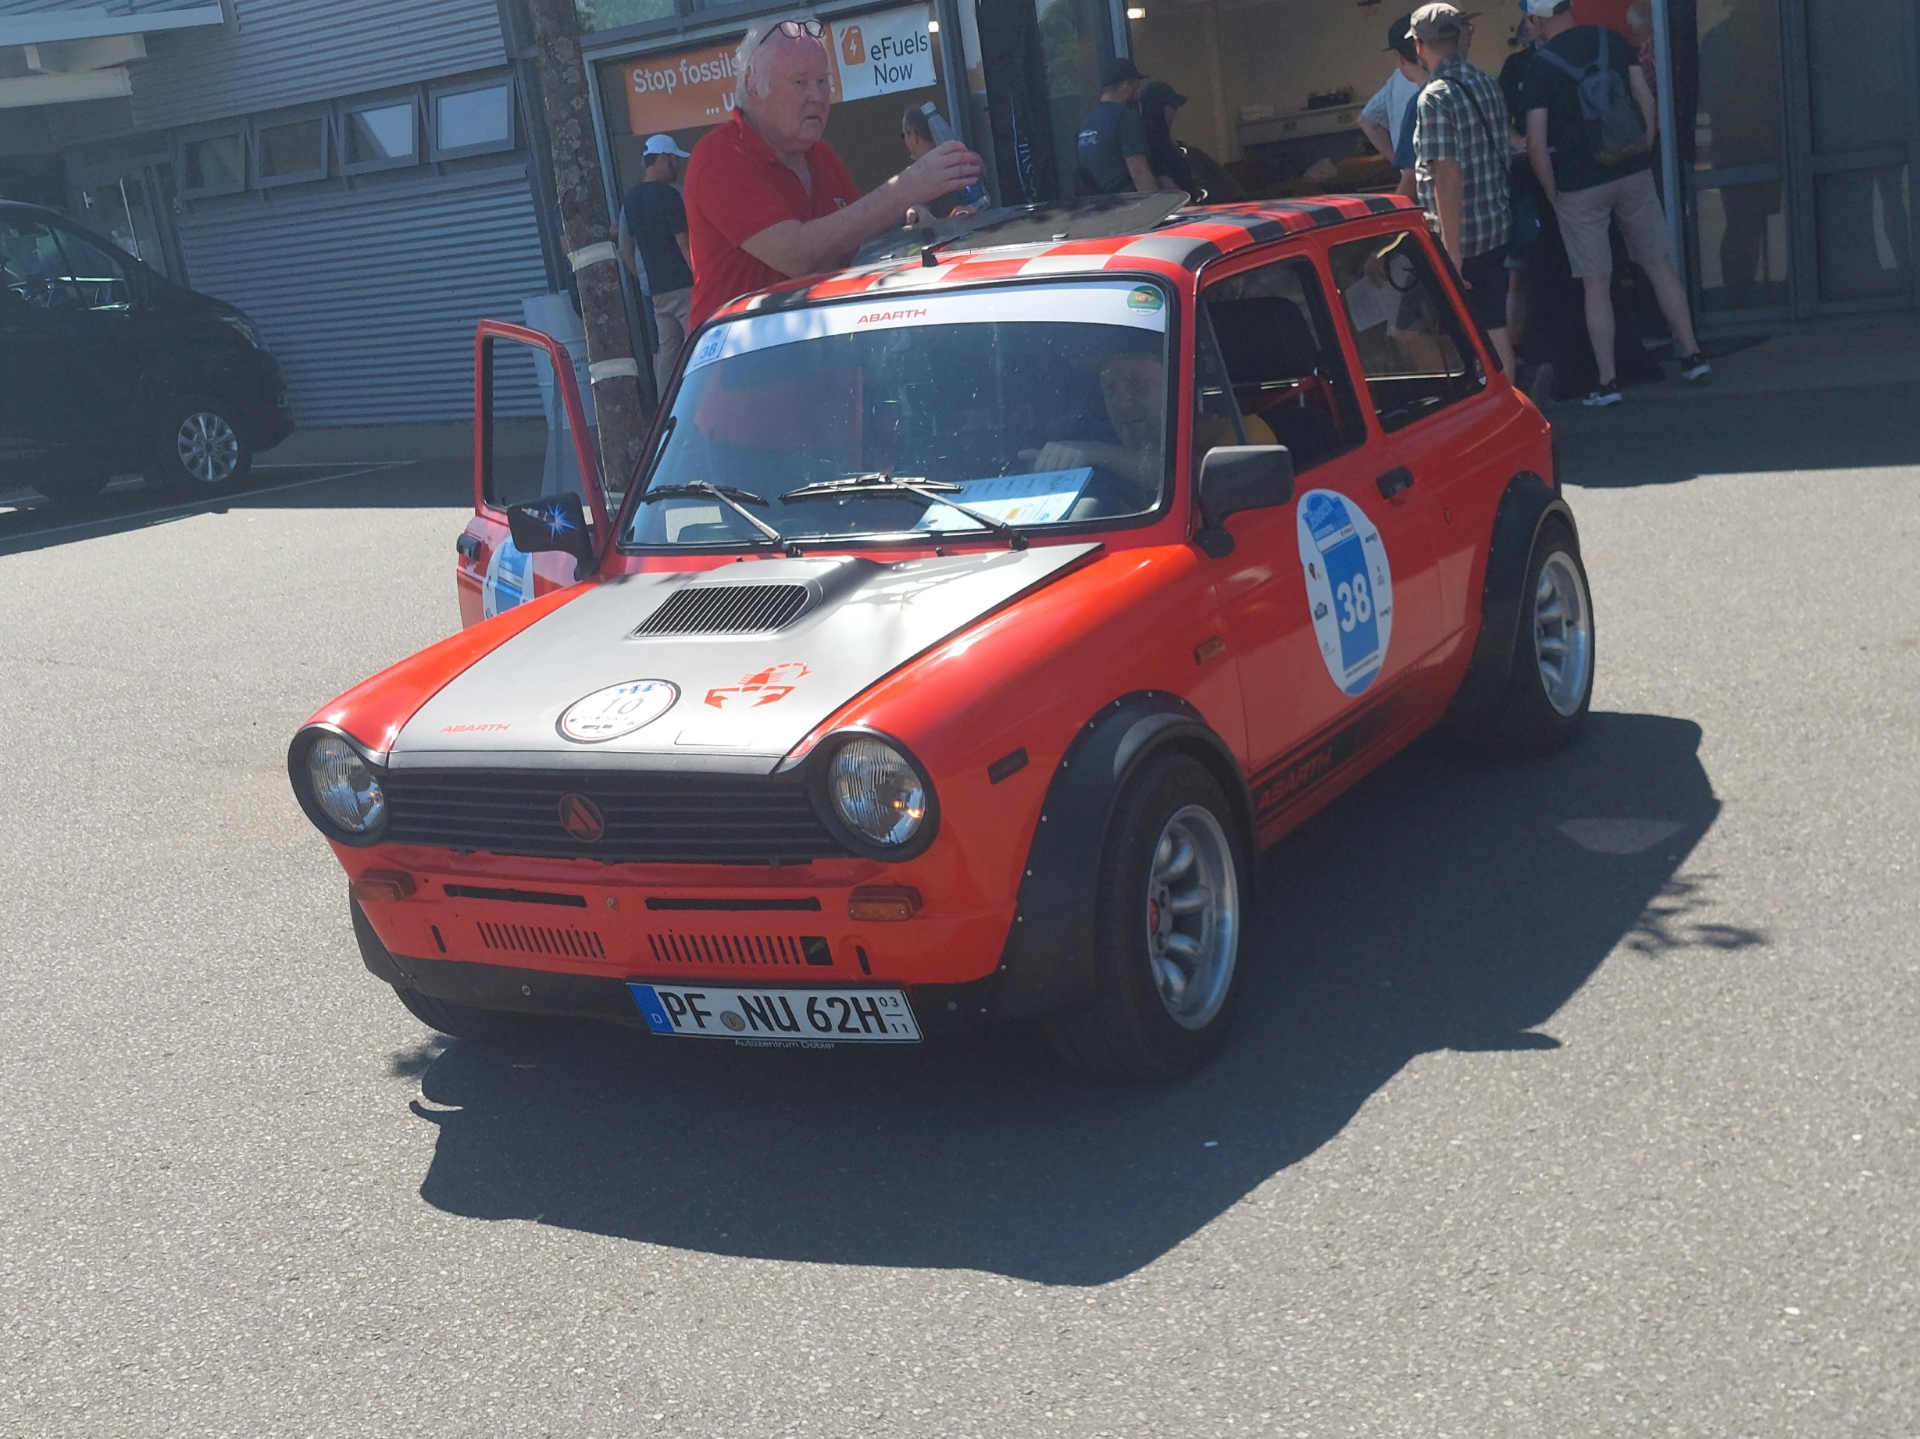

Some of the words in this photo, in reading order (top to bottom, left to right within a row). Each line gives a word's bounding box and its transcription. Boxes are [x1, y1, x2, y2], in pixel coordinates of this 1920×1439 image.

[870, 31, 928, 61] eFuels
[633, 68, 677, 95] Stop
[873, 63, 913, 86] Now
[857, 308, 927, 325] ABARTH
[699, 342, 719, 360] 38
[1336, 573, 1372, 633] 38
[440, 723, 512, 733] ABARTH
[1258, 746, 1332, 808] ABARTH
[658, 992, 713, 1029] PF
[737, 995, 801, 1032] NU
[806, 996, 888, 1034] 62H
[878, 997, 899, 1008] 03
[735, 1039, 799, 1048] Autozentrum
